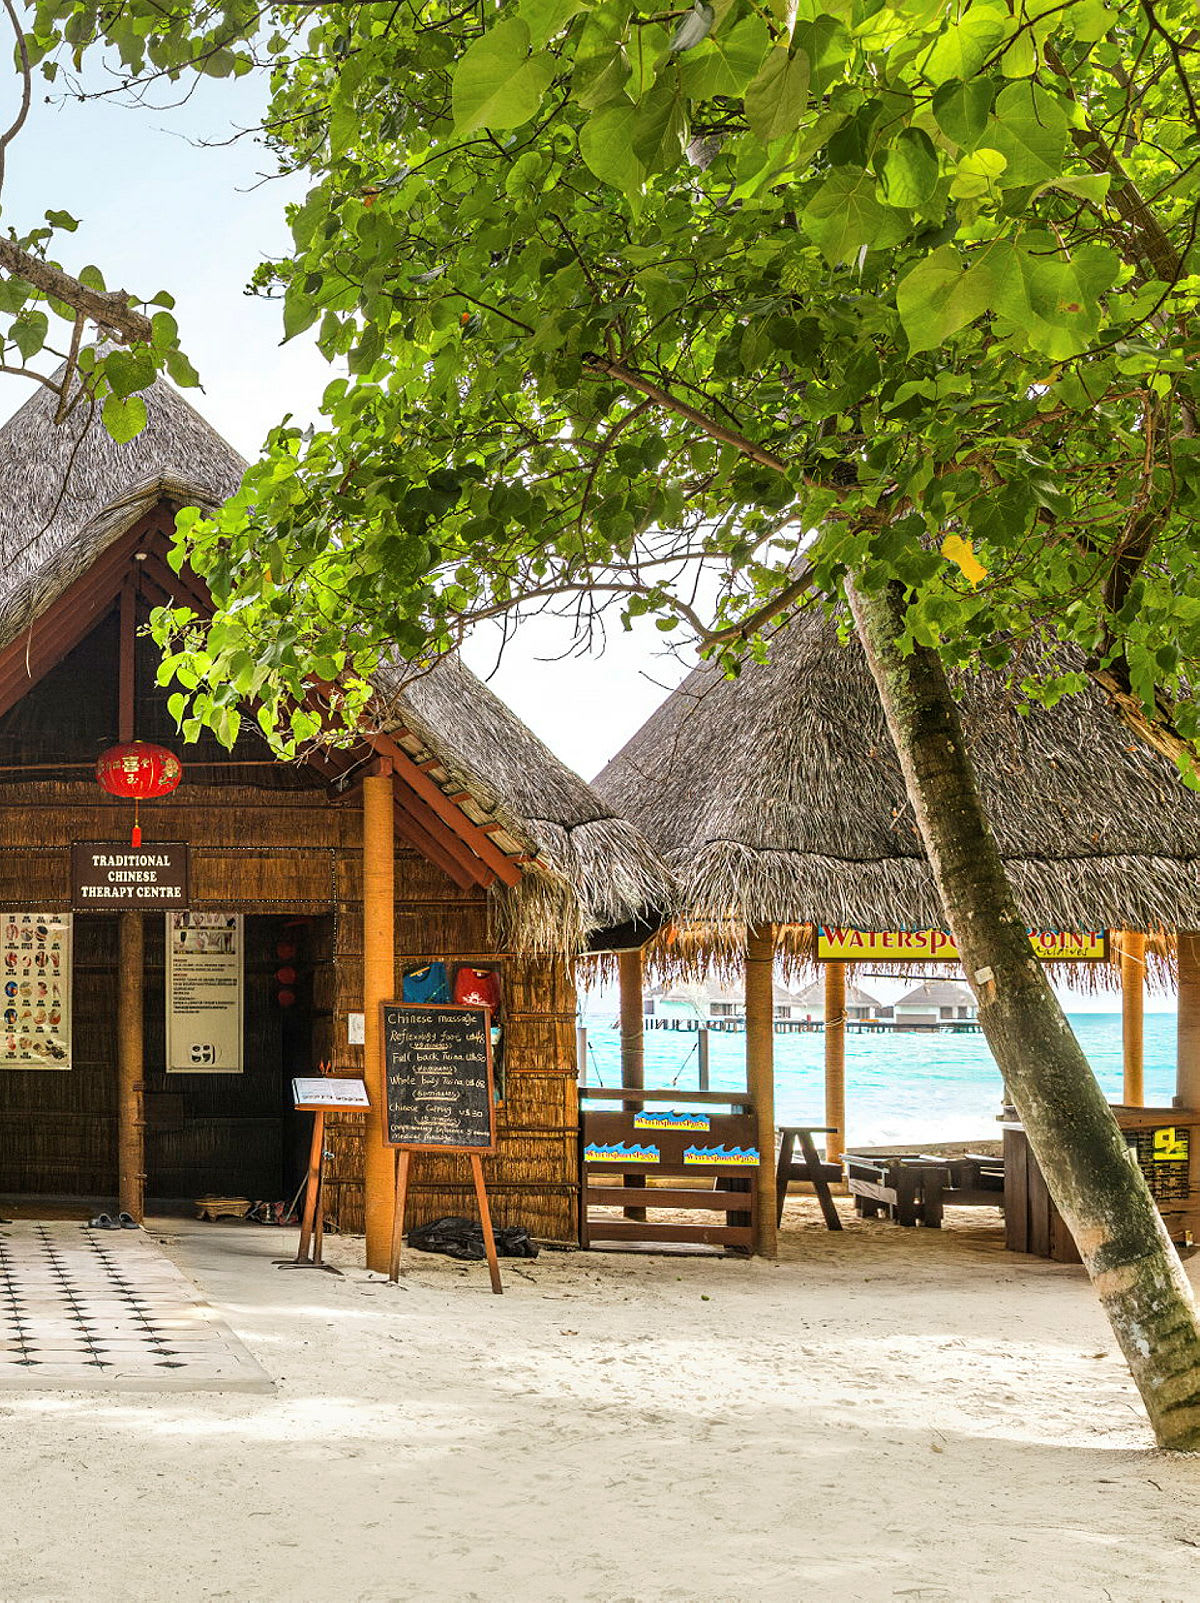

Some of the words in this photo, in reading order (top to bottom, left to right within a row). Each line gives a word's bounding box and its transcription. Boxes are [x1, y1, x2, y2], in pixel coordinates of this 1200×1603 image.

[92, 855, 171, 867] TRADITIONAL
[107, 871, 157, 882] CHINESE
[81, 886, 135, 898] THERAPY
[136, 886, 181, 898] CENTRE
[388, 1013, 433, 1024] Chinese
[438, 1013, 477, 1026] massage
[416, 1052, 439, 1061] back
